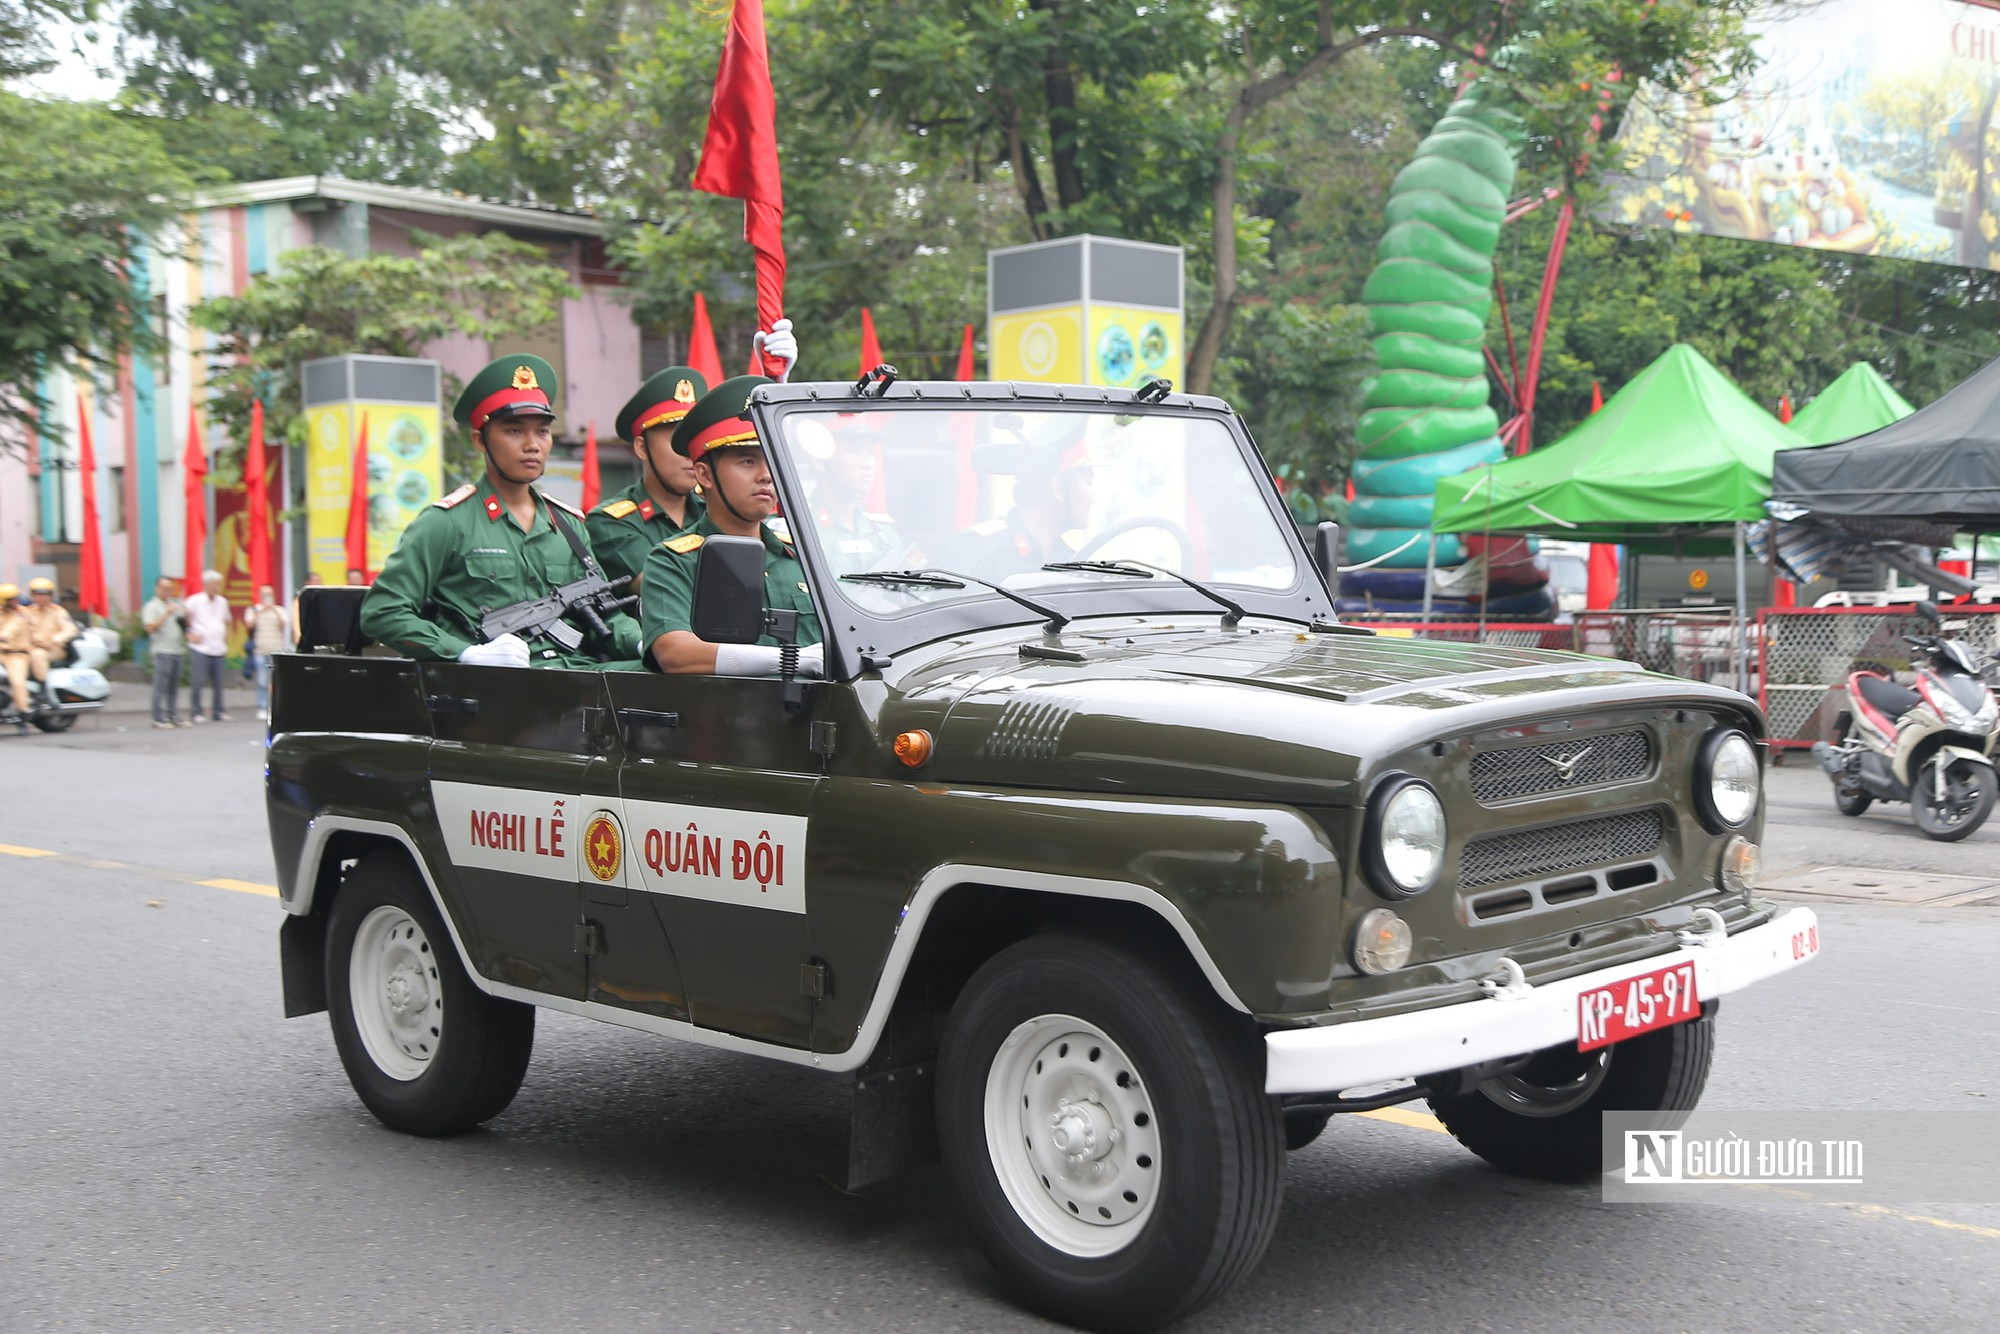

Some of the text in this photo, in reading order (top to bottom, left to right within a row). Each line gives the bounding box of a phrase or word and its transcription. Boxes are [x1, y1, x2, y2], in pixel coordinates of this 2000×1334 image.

[470, 799, 784, 893] NGHI LỄ QUÂN ĐỘI
[1580, 965, 1693, 1044] KP-45-97
